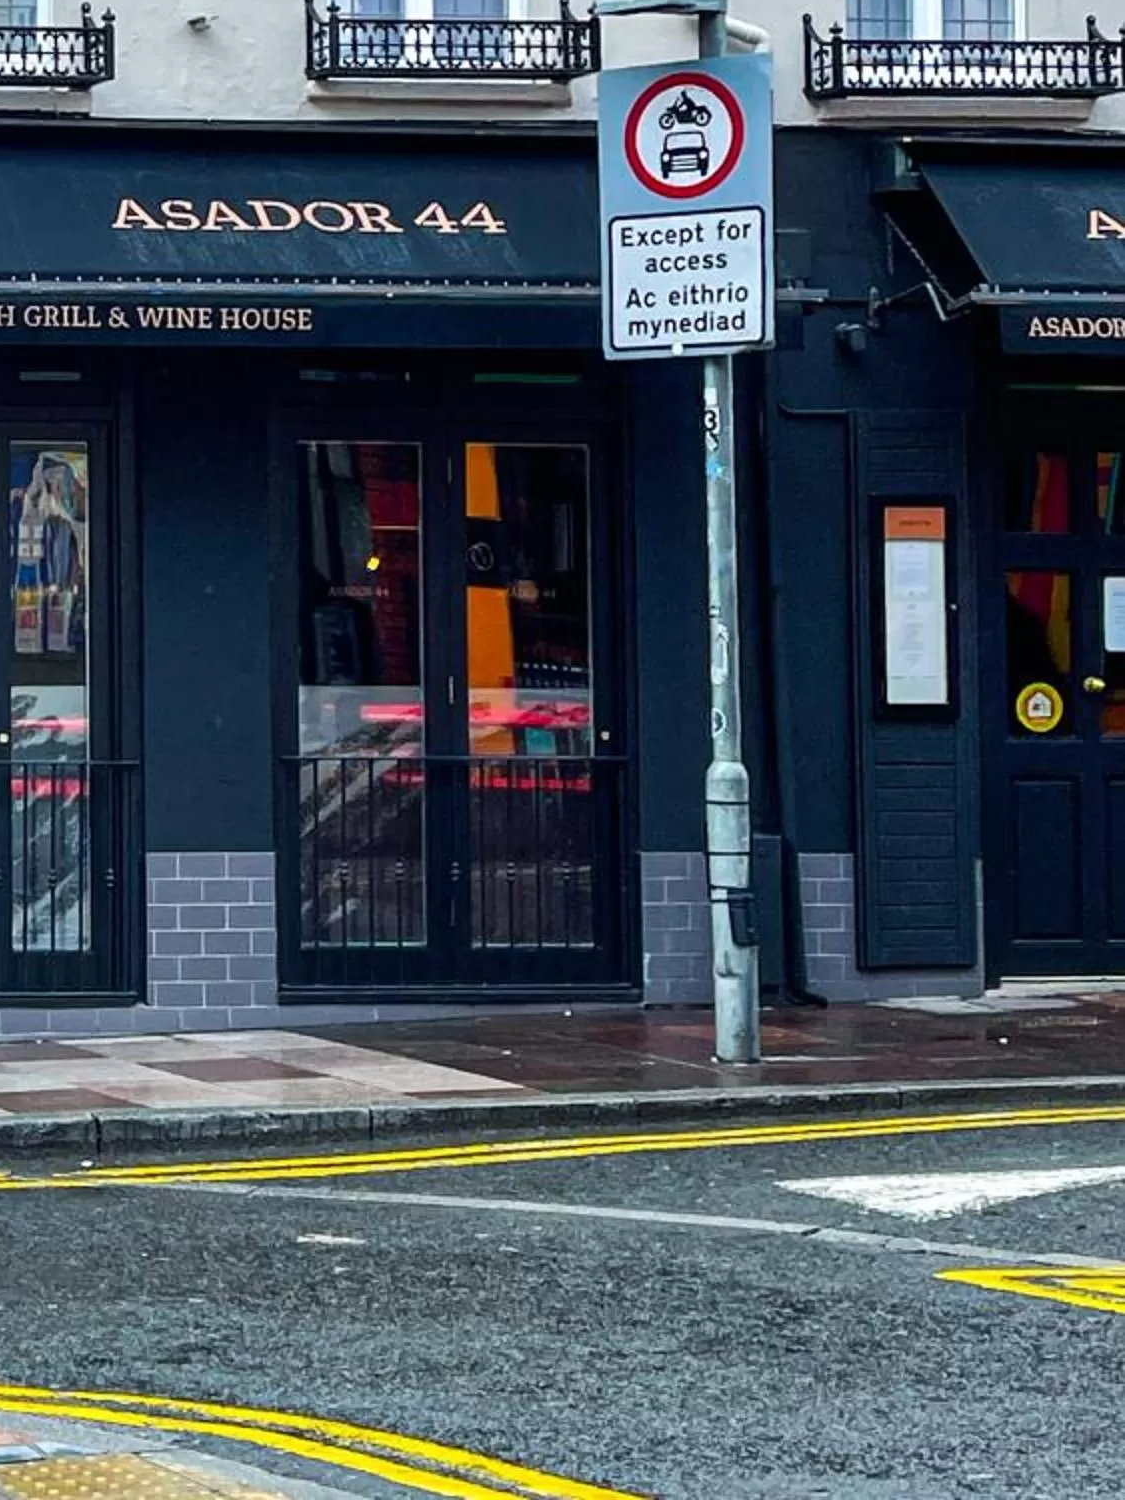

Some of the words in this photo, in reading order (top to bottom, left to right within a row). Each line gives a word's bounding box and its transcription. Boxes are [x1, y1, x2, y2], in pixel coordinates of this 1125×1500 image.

[111, 199, 404, 233] ASADOR
[413, 202, 507, 234] 44
[620, 224, 704, 248] Except
[716, 219, 752, 241] for
[644, 252, 728, 273] access
[625, 287, 657, 309] Ac
[668, 283, 749, 307] eithrio
[23, 305, 102, 328] GRILL
[108, 306, 130, 328] &
[136, 306, 212, 329] WINE
[220, 307, 312, 331] HOUSE
[628, 310, 746, 340] mynediad
[1028, 316, 1125, 338] ASADOR
